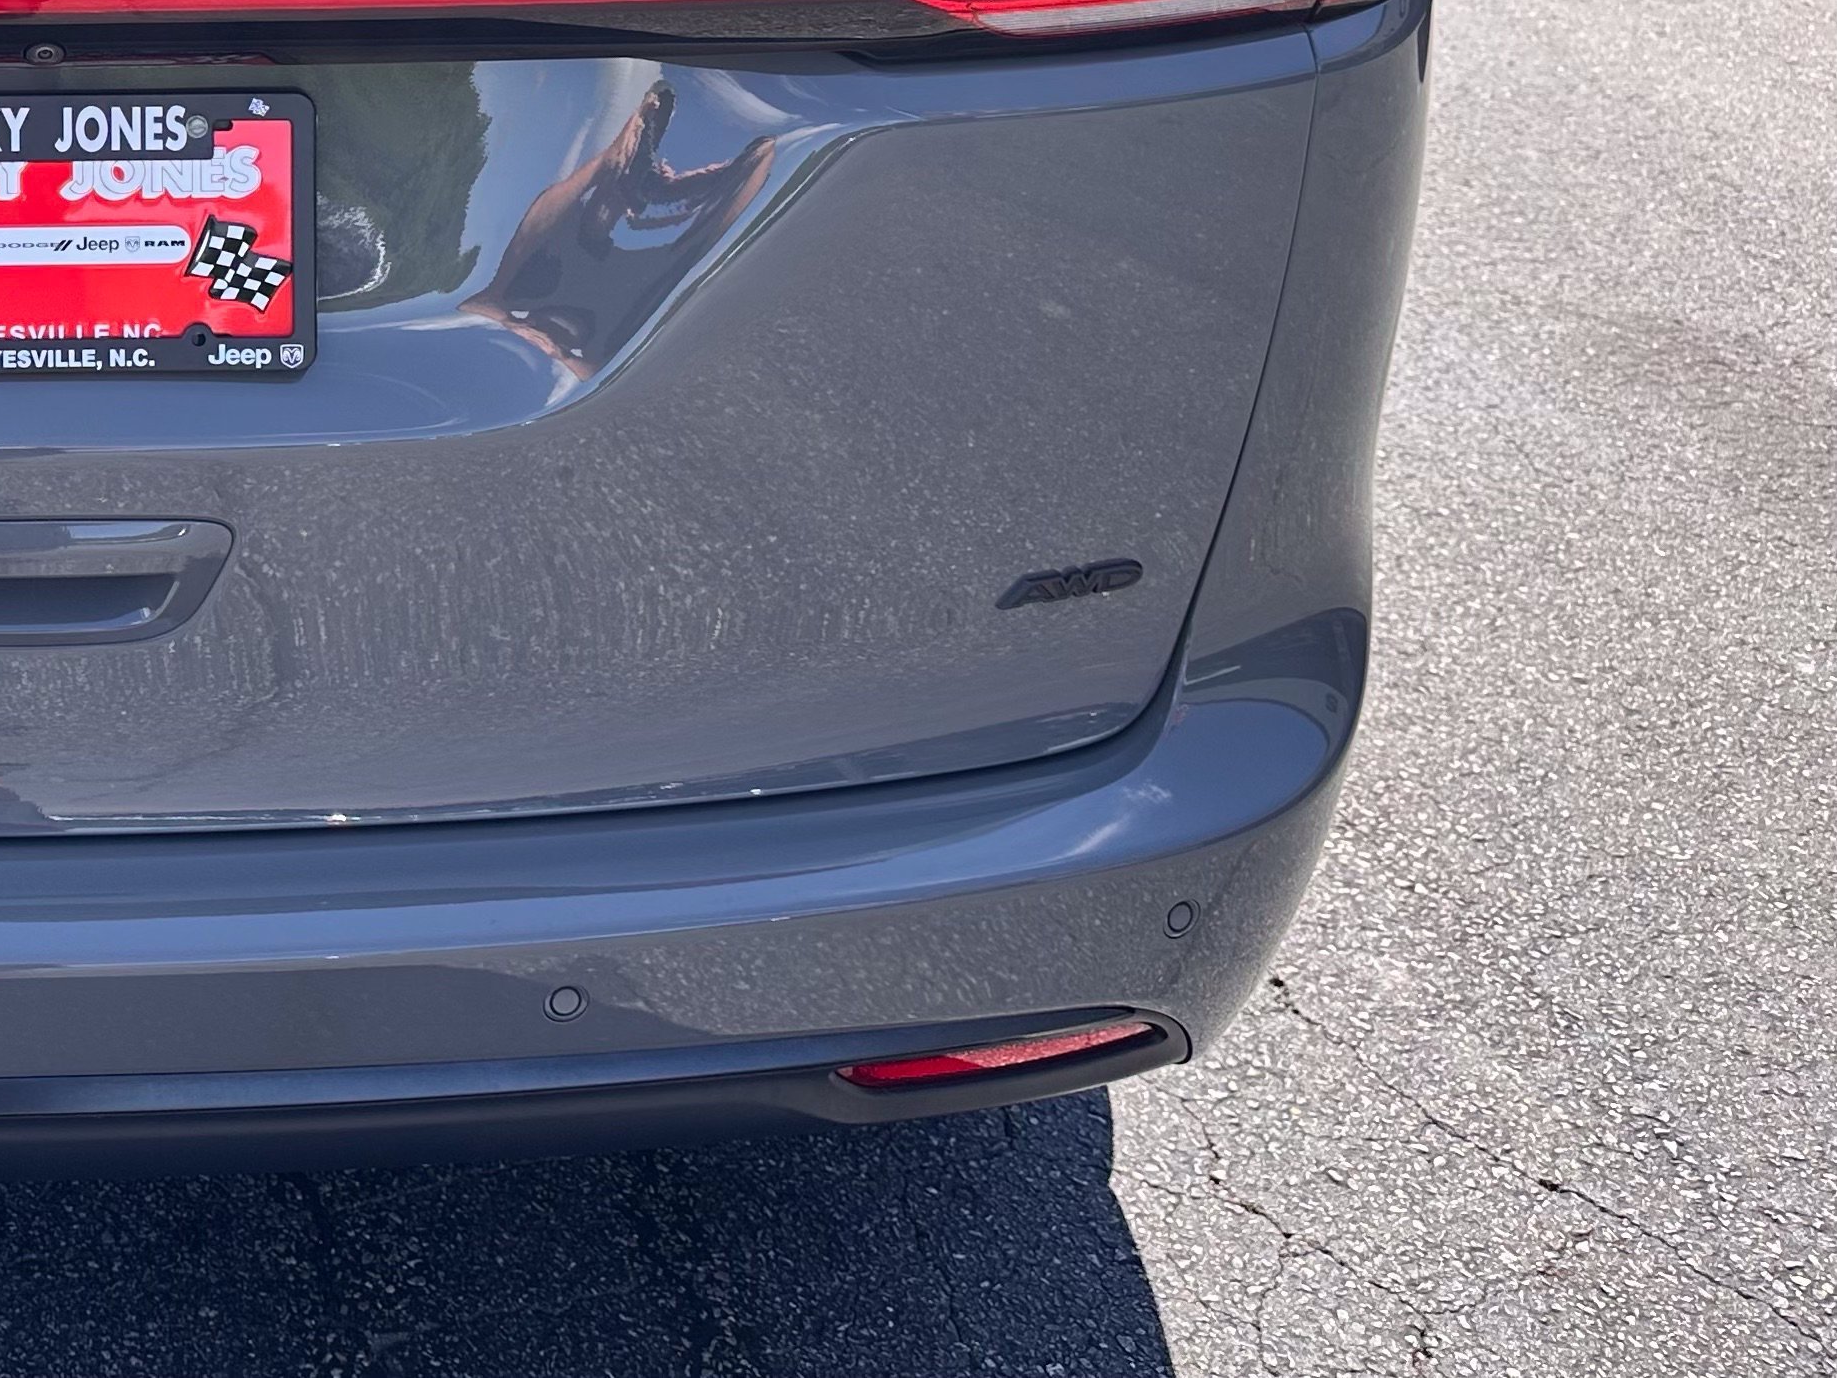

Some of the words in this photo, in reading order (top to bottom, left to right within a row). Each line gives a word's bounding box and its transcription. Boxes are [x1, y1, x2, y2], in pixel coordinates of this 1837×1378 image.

[54, 105, 188, 152] JONES
[60, 145, 262, 200] JONES
[76, 236, 120, 253] Jeep
[109, 348, 156, 368] N.C.
[208, 343, 272, 369] Jeep
[995, 558, 1143, 610] AWD
